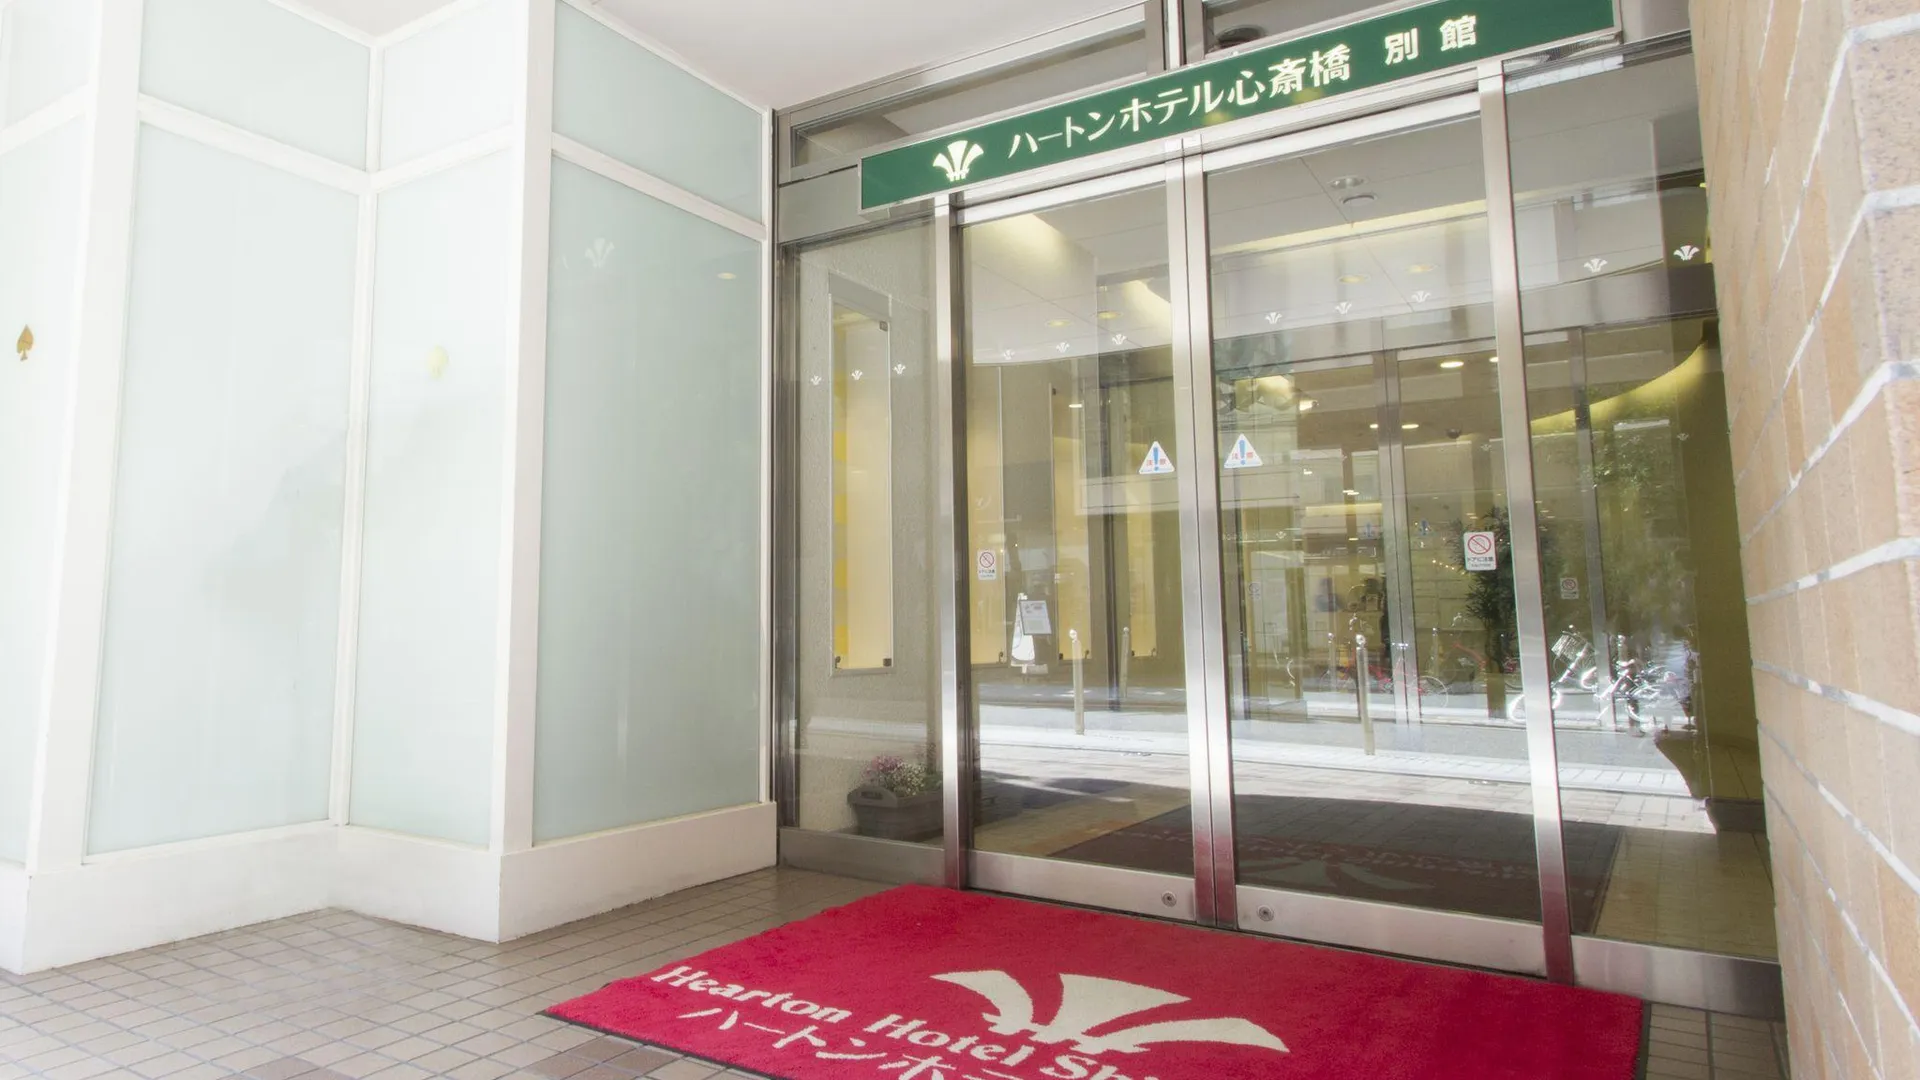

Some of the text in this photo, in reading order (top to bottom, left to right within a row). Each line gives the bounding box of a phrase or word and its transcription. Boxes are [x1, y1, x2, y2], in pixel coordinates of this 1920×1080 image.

[1007, 43, 1351, 160] ハートンホテル心斎橋
[650, 965, 852, 1024] Hearton
[862, 1013, 1036, 1067] Hotel
